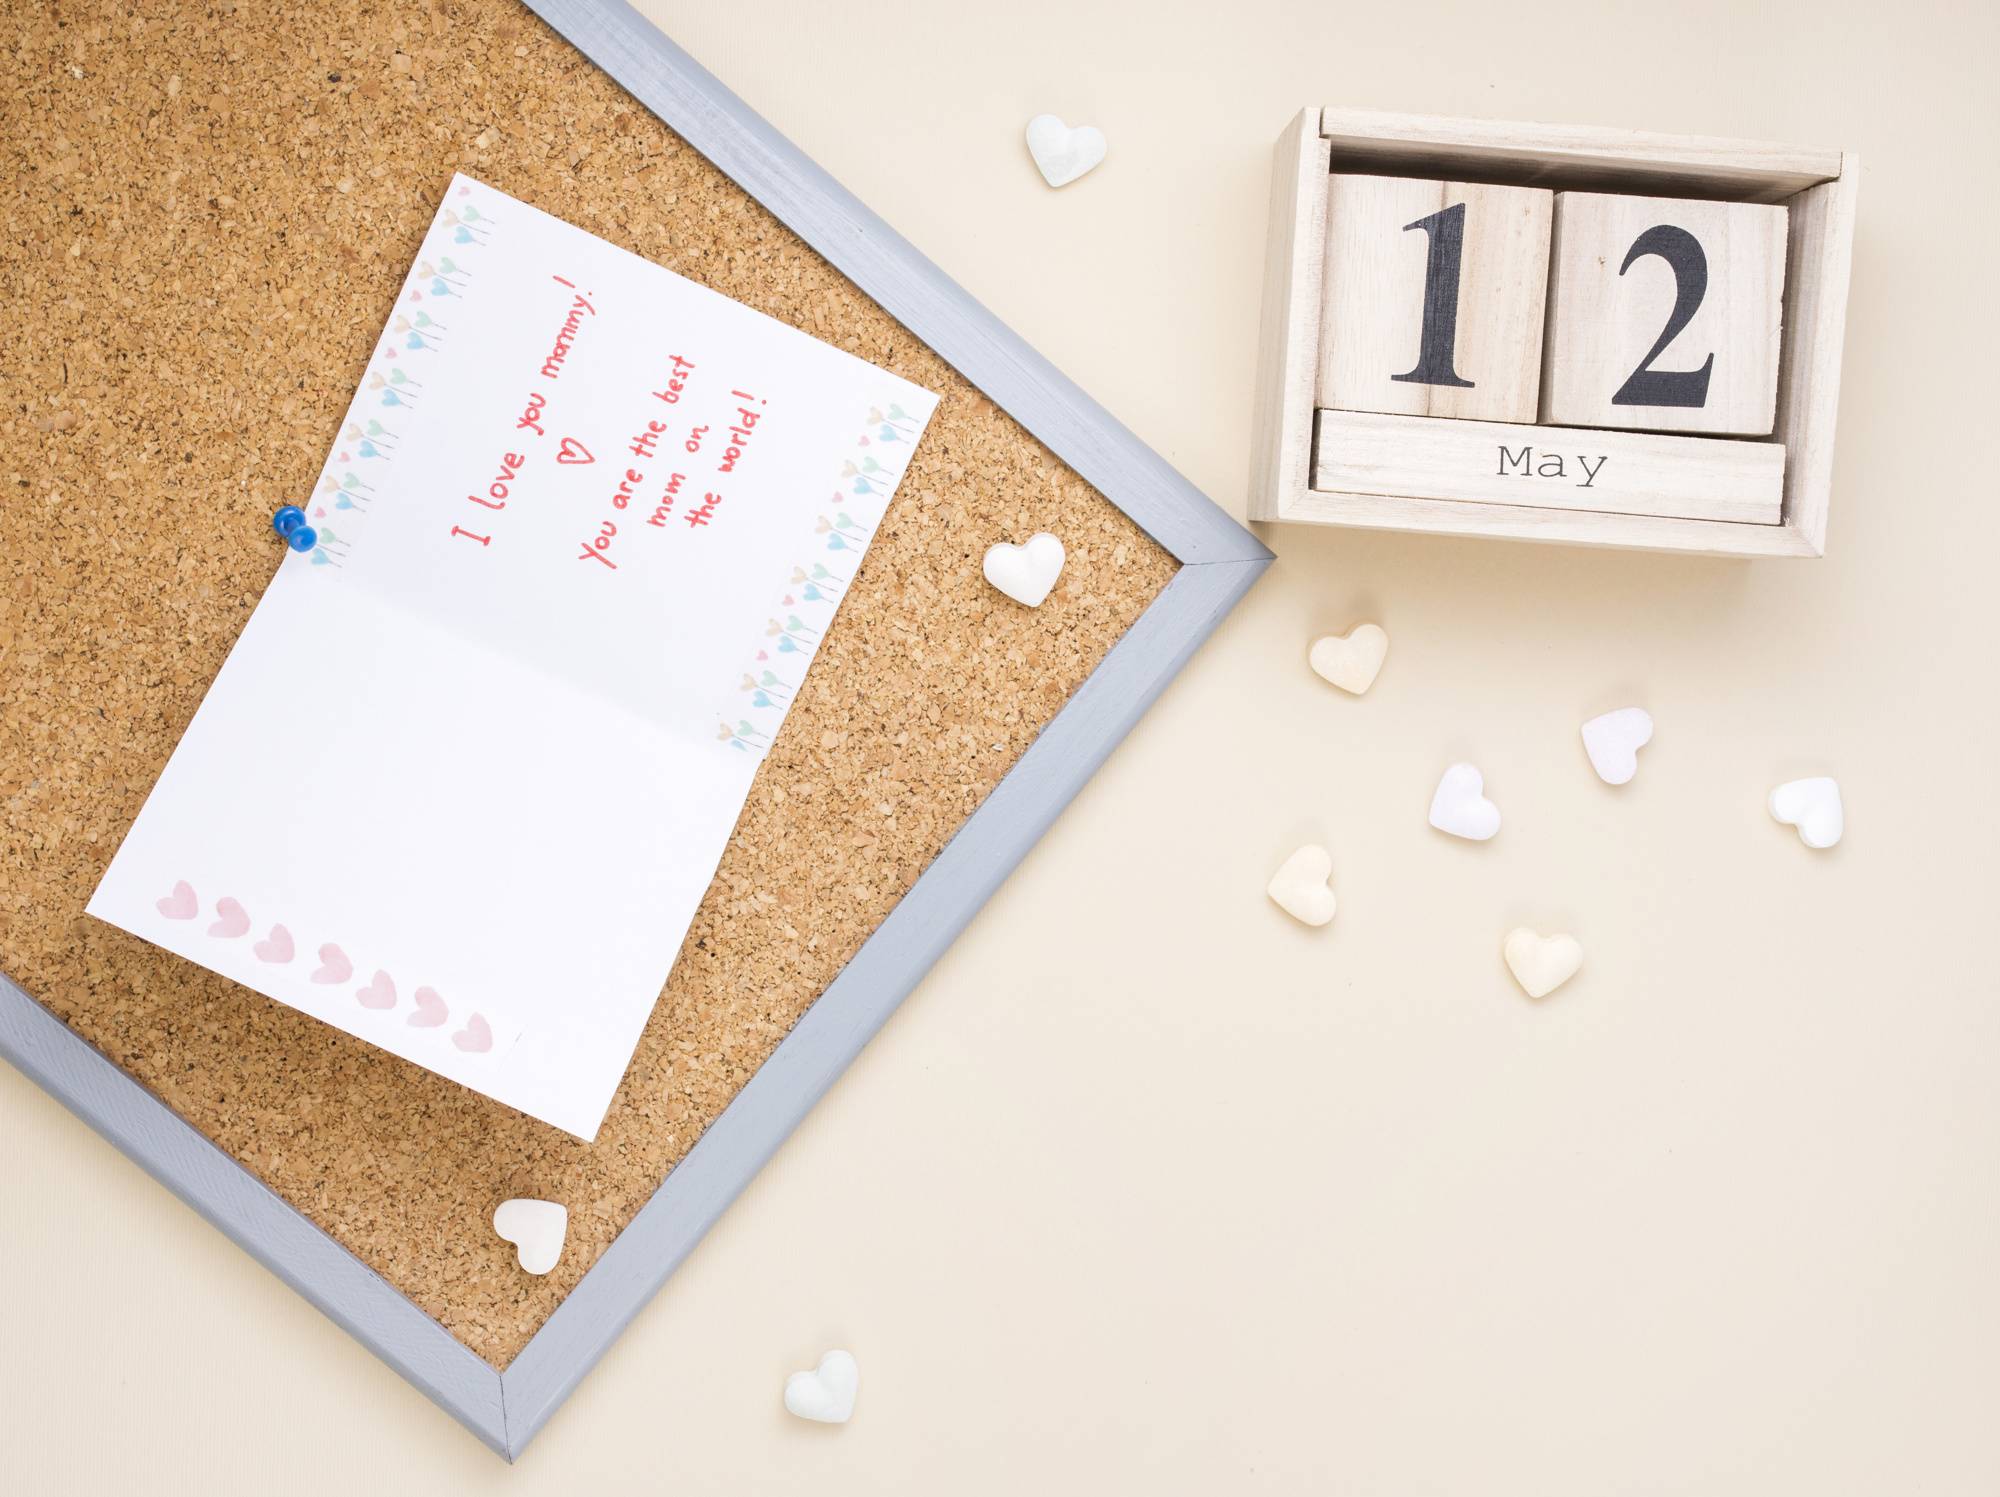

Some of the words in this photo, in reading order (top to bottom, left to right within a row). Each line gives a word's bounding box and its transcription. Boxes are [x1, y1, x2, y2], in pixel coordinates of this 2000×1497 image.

[540, 275, 597, 380] mommy!
[515, 392, 547, 437] you
[612, 468, 644, 510] are
[628, 420, 667, 459] the
[652, 354, 696, 405] best
[467, 452, 526, 511] love
[646, 472, 687, 528] mom
[684, 424, 710, 453] on
[683, 491, 723, 529] the
[717, 389, 768, 473] world!
[1496, 445, 1608, 488] May
[450, 525, 492, 547] I
